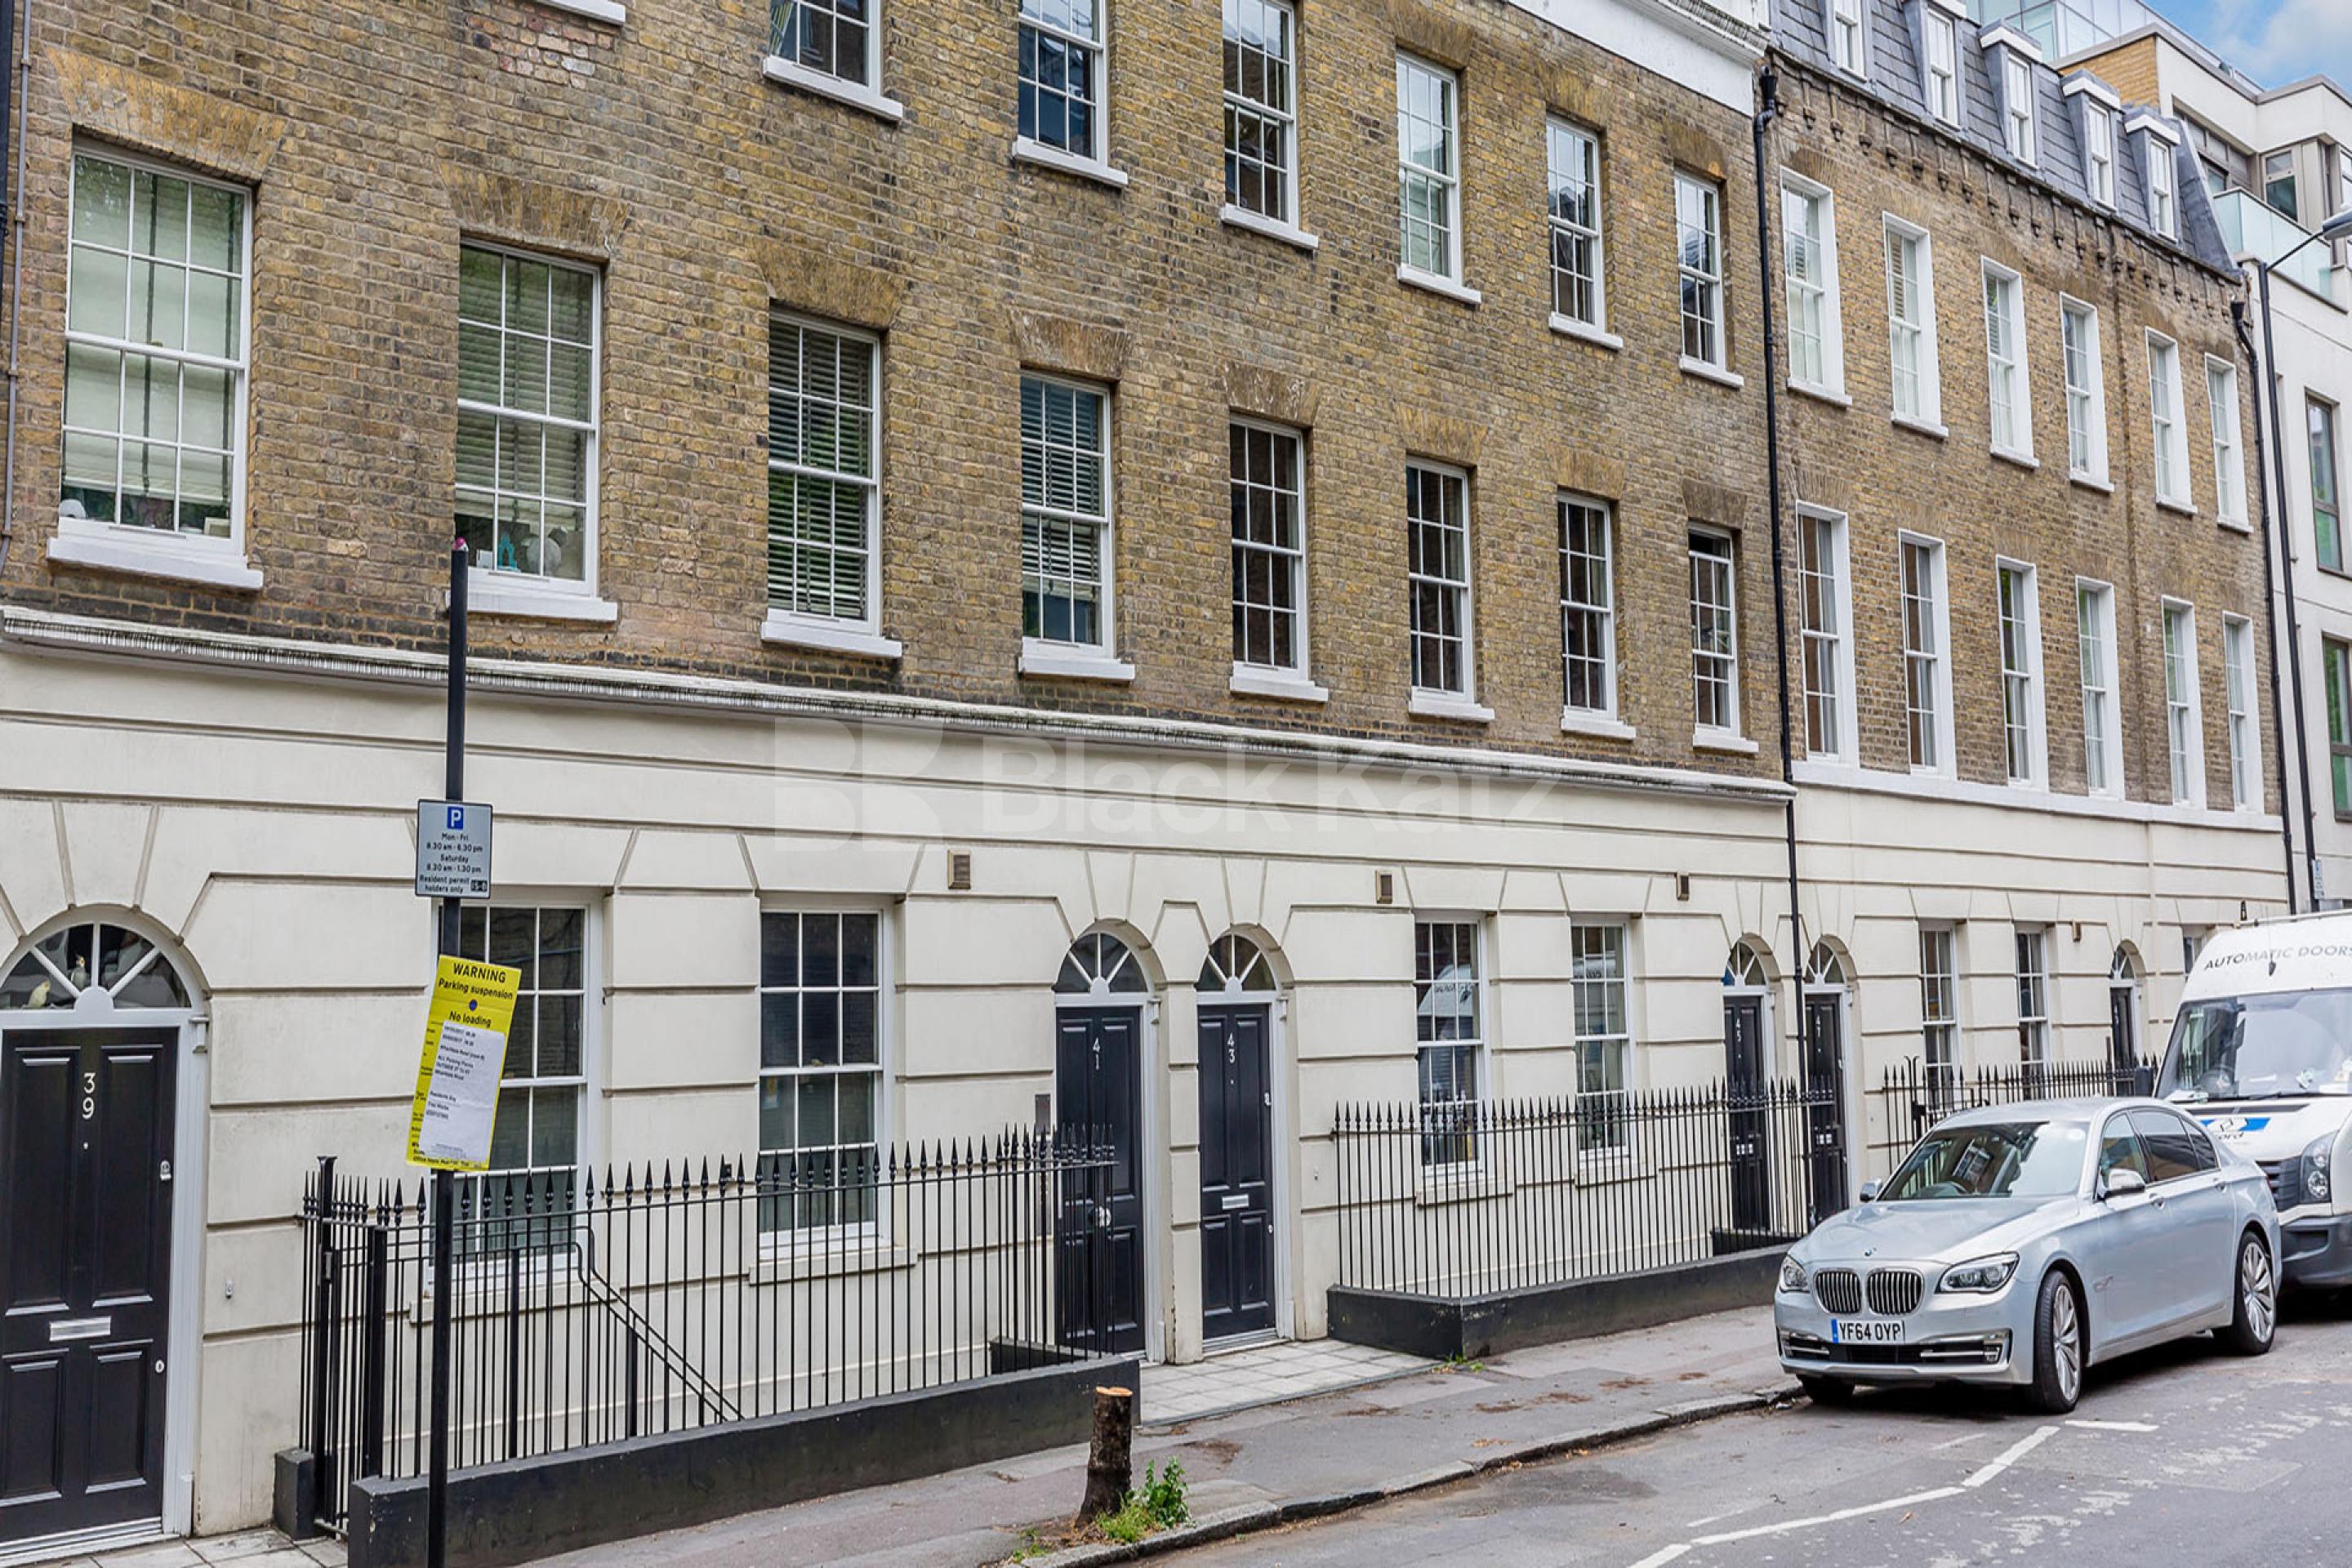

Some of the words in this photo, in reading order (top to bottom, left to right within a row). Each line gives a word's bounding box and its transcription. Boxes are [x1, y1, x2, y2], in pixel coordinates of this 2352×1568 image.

[451, 809, 461, 828] P
[442, 833, 456, 841] Mon
[441, 854, 469, 863] Saturday
[420, 874, 448, 884] Resident
[449, 876, 470, 885] permit
[425, 884, 448, 893] holders
[450, 886, 463, 894] only
[2205, 947, 2293, 970] AUTOMATIC
[453, 963, 506, 983] WARNING
[439, 978, 469, 994] Parking
[470, 985, 513, 1000] suspension
[450, 1011, 461, 1022] No
[463, 1013, 492, 1028] loading
[1093, 1036, 1100, 1071] 41
[1227, 1032, 1236, 1064] 43
[82, 1071, 96, 1120] 39
[1839, 1323, 1871, 1340] YF64
